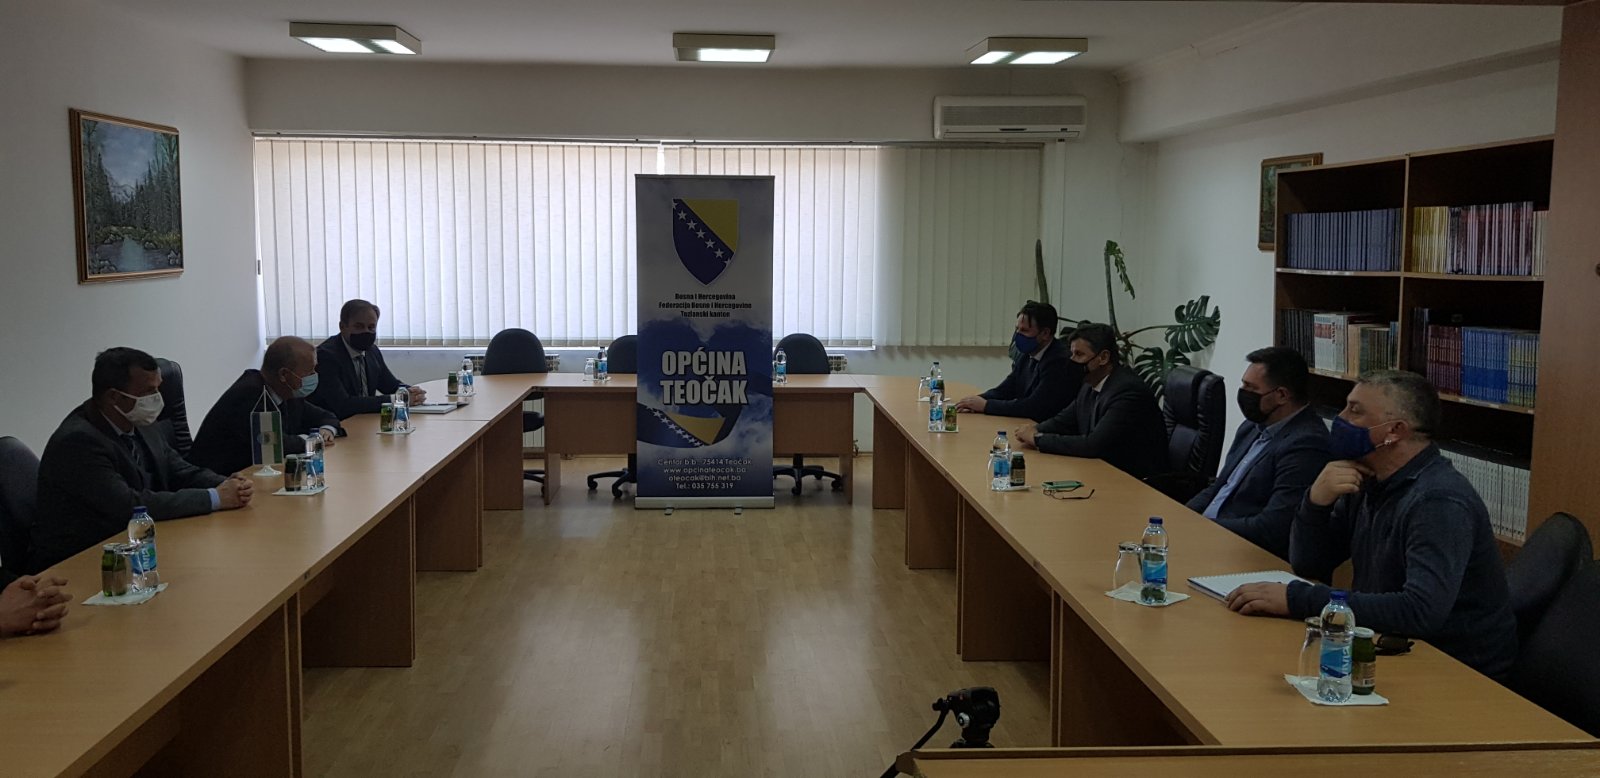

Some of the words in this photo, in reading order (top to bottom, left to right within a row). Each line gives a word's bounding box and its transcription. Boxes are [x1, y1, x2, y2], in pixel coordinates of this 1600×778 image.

[698, 293, 736, 301] Hercegovina
[661, 347, 747, 376] OPĆINA
[660, 376, 748, 405] TEOČAK
[663, 466, 746, 474] www.opcinateocak.ba
